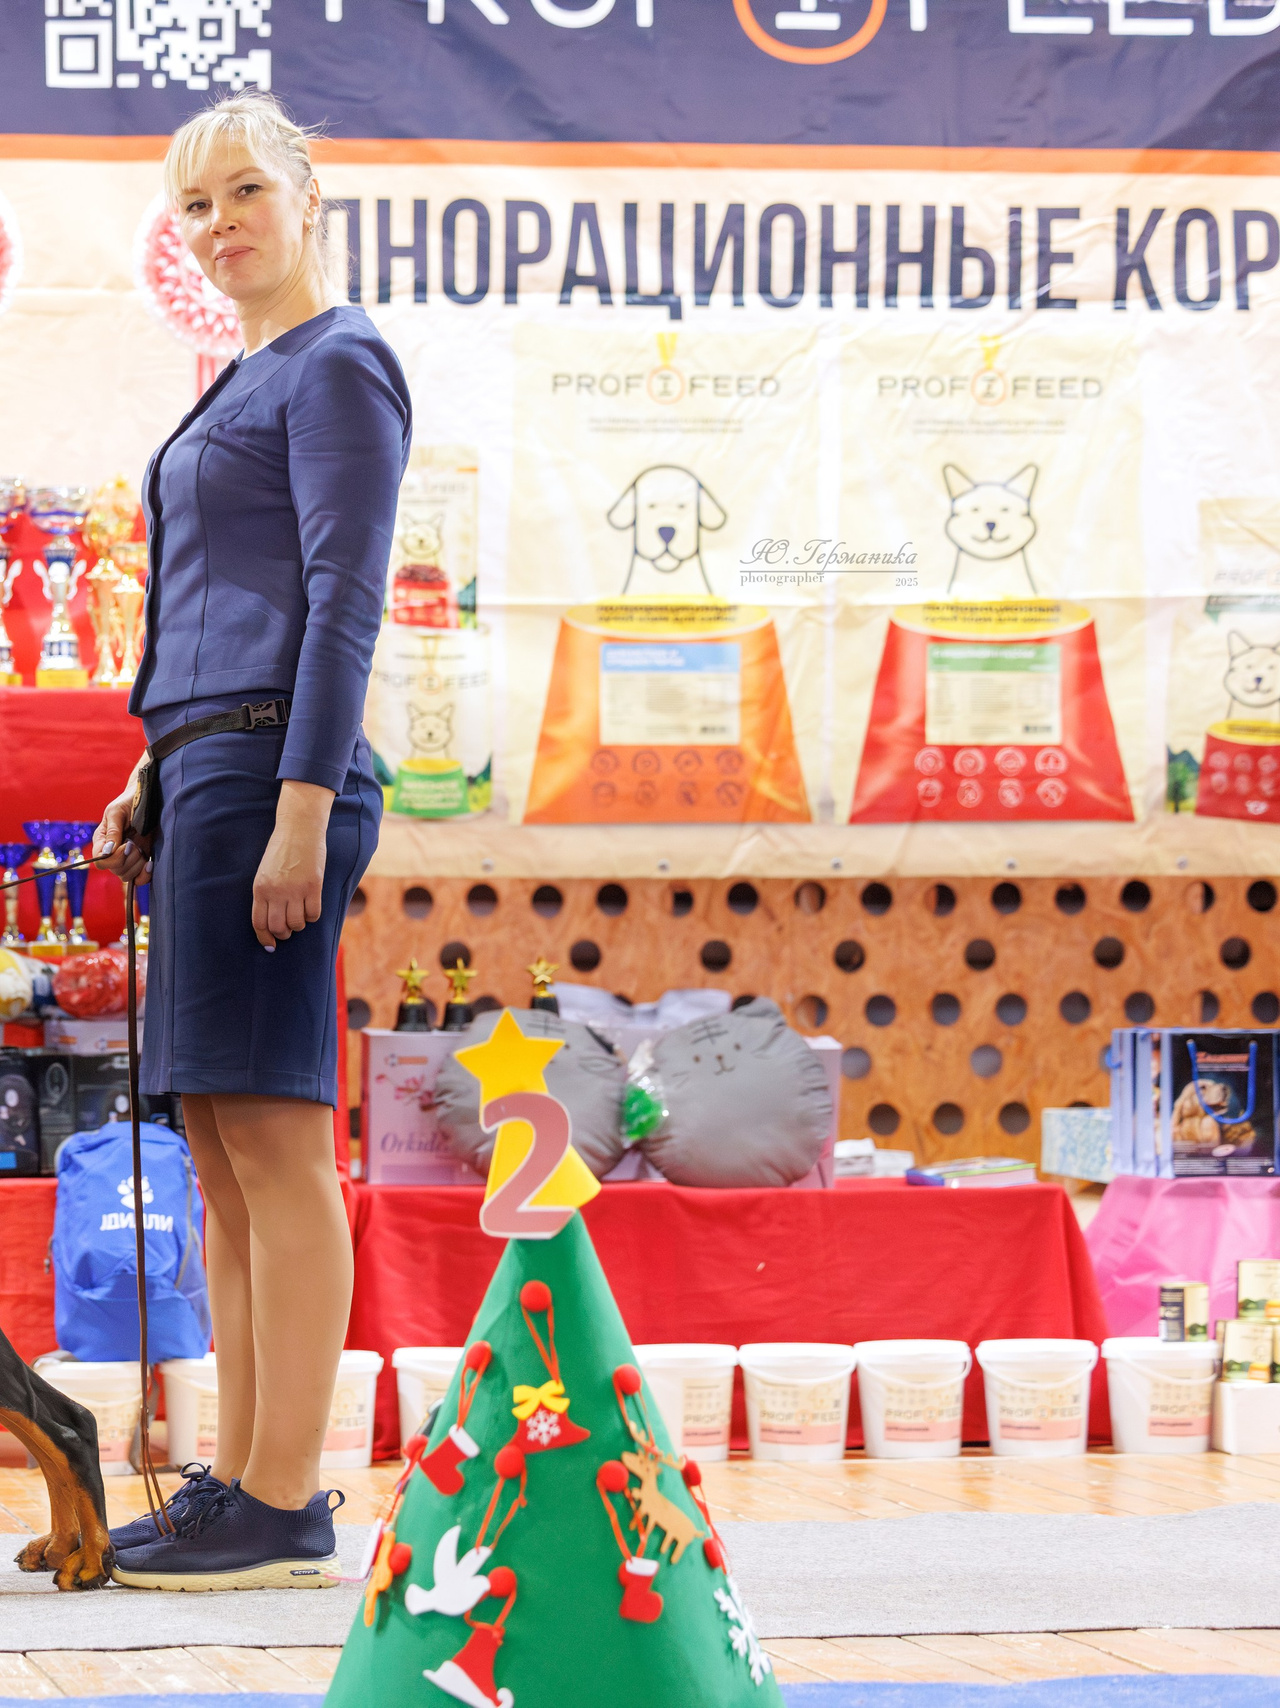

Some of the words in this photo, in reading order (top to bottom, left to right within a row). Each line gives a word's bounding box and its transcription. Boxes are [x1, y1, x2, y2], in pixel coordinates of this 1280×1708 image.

[1112, 207, 1280, 312] КОР
[479, 1090, 578, 1240] 2
[98, 1210, 175, 1234] ДИЛИ
